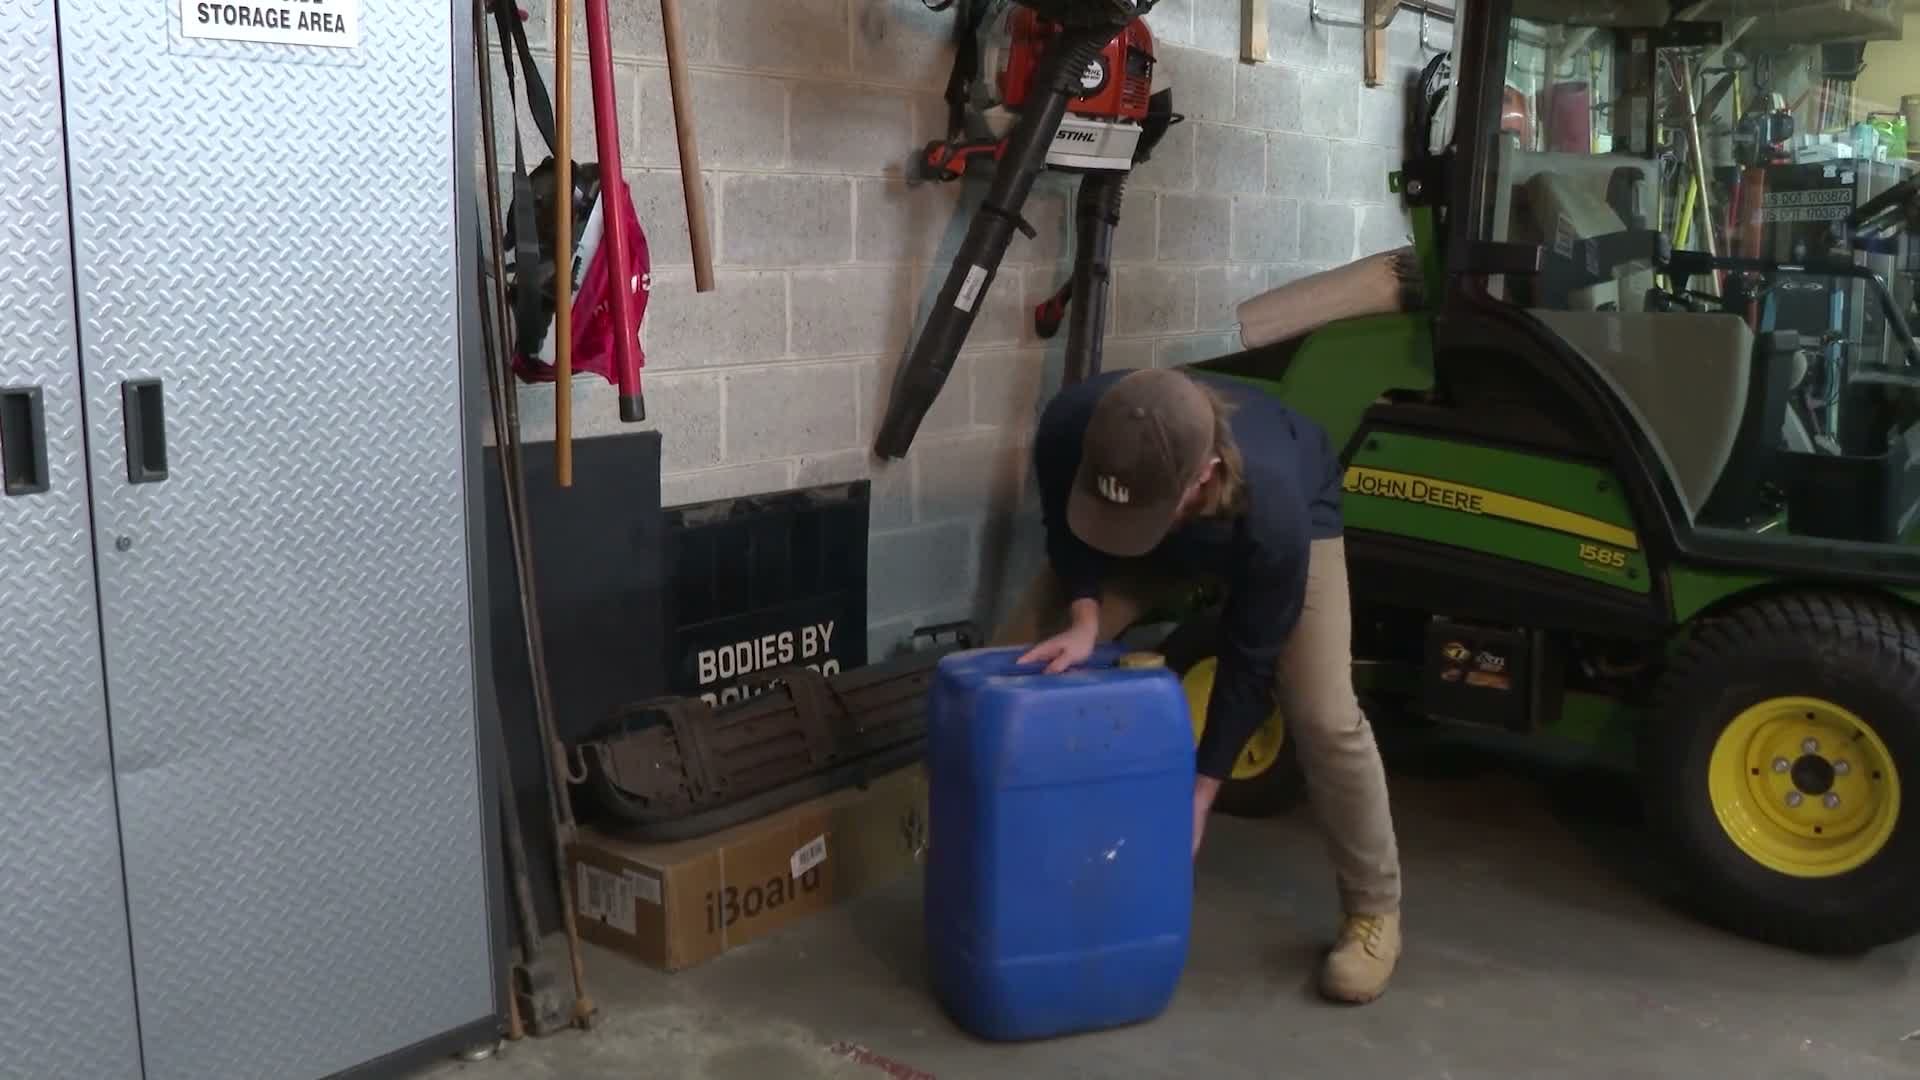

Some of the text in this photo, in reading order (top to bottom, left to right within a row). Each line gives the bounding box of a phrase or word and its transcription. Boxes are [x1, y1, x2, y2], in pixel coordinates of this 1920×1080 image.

[197, 2, 346, 33] STORAGE AREA
[1056, 130, 1095, 142] STIHL
[1808, 190, 1850, 202] 1703873
[1348, 472, 1484, 512] JOHN DEERE
[1578, 543, 1625, 567] 1585
[698, 631, 794, 685] BODIES
[801, 620, 834, 658] BY
